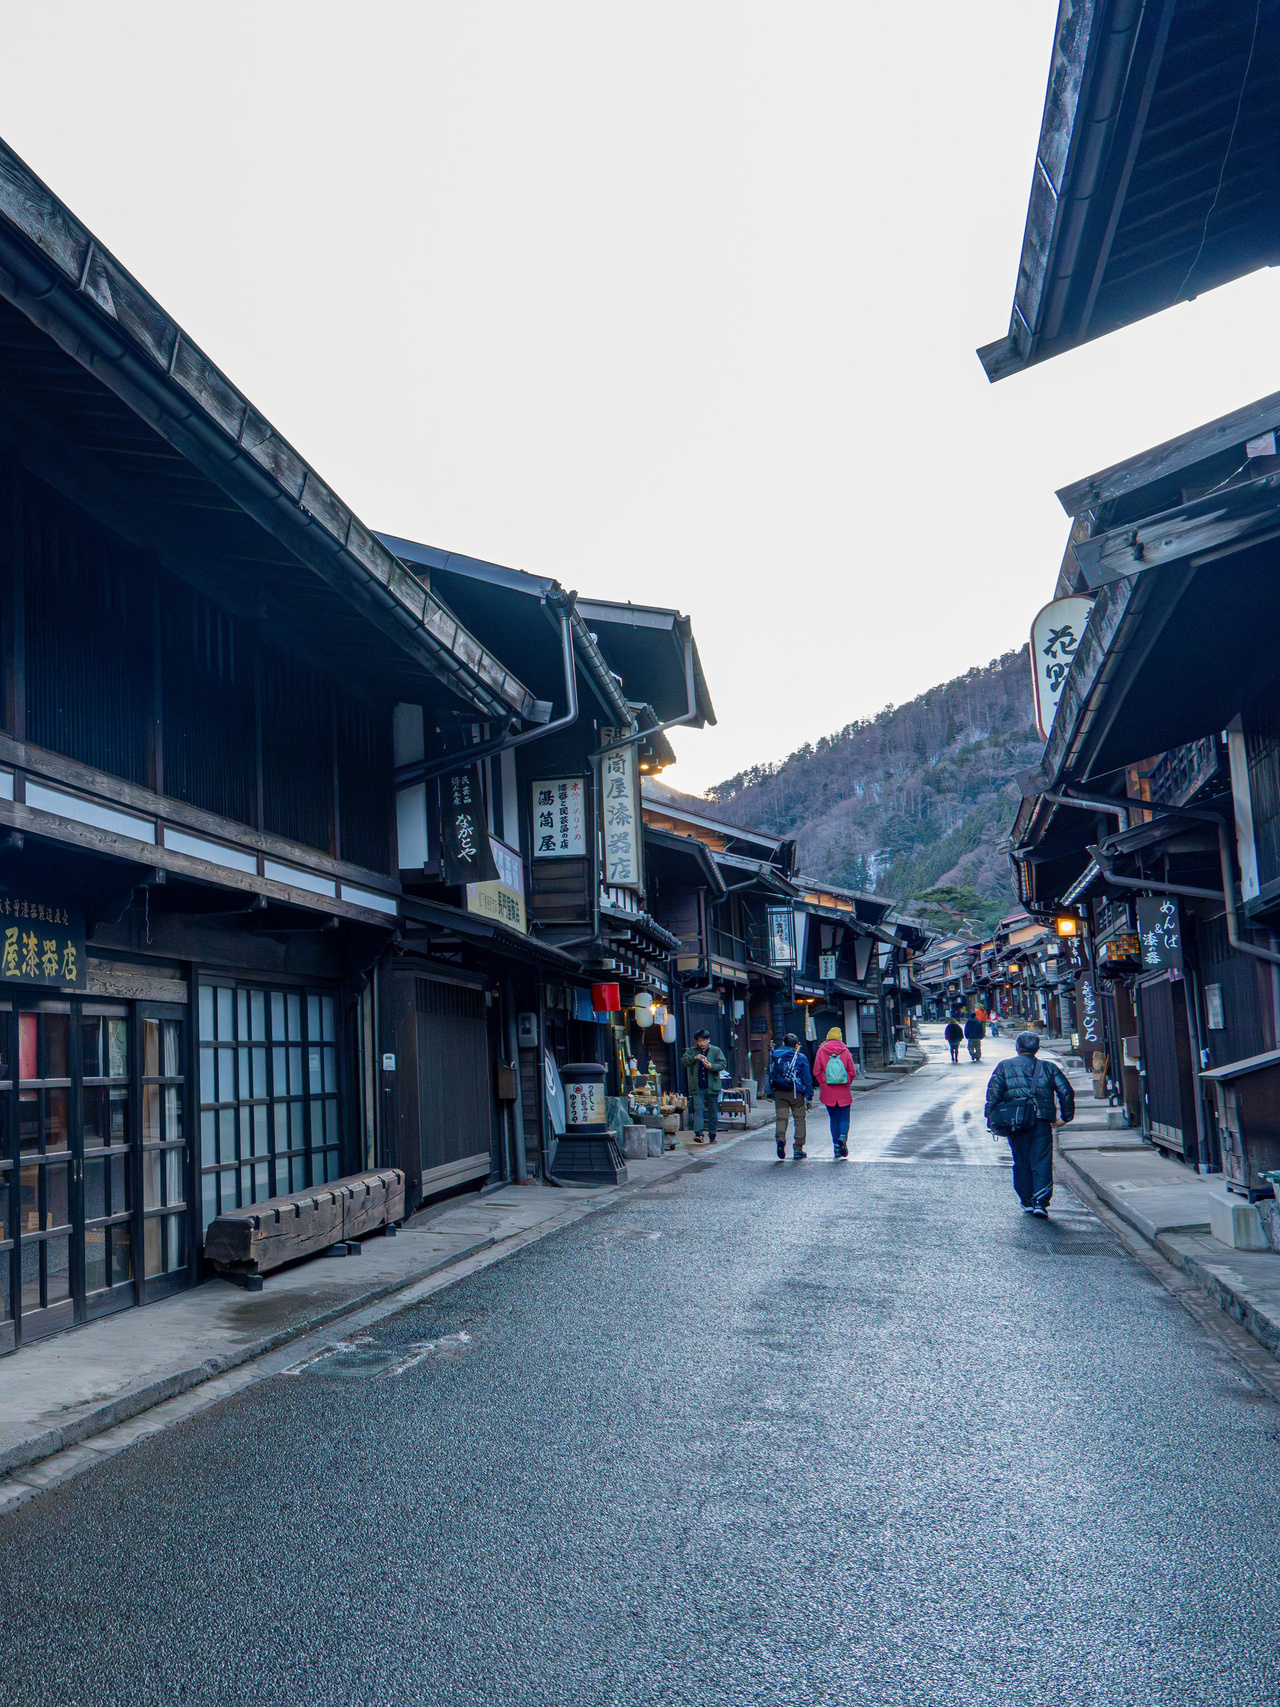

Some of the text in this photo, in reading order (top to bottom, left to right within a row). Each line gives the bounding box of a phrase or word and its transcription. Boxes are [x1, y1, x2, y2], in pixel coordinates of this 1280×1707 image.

[1042, 625, 1078, 708] 花野
[455, 813, 477, 863] ながとや
[538, 790, 556, 852] 湯筒屋
[1142, 930, 1162, 964] 漆の器
[1154, 923, 1164, 934] &
